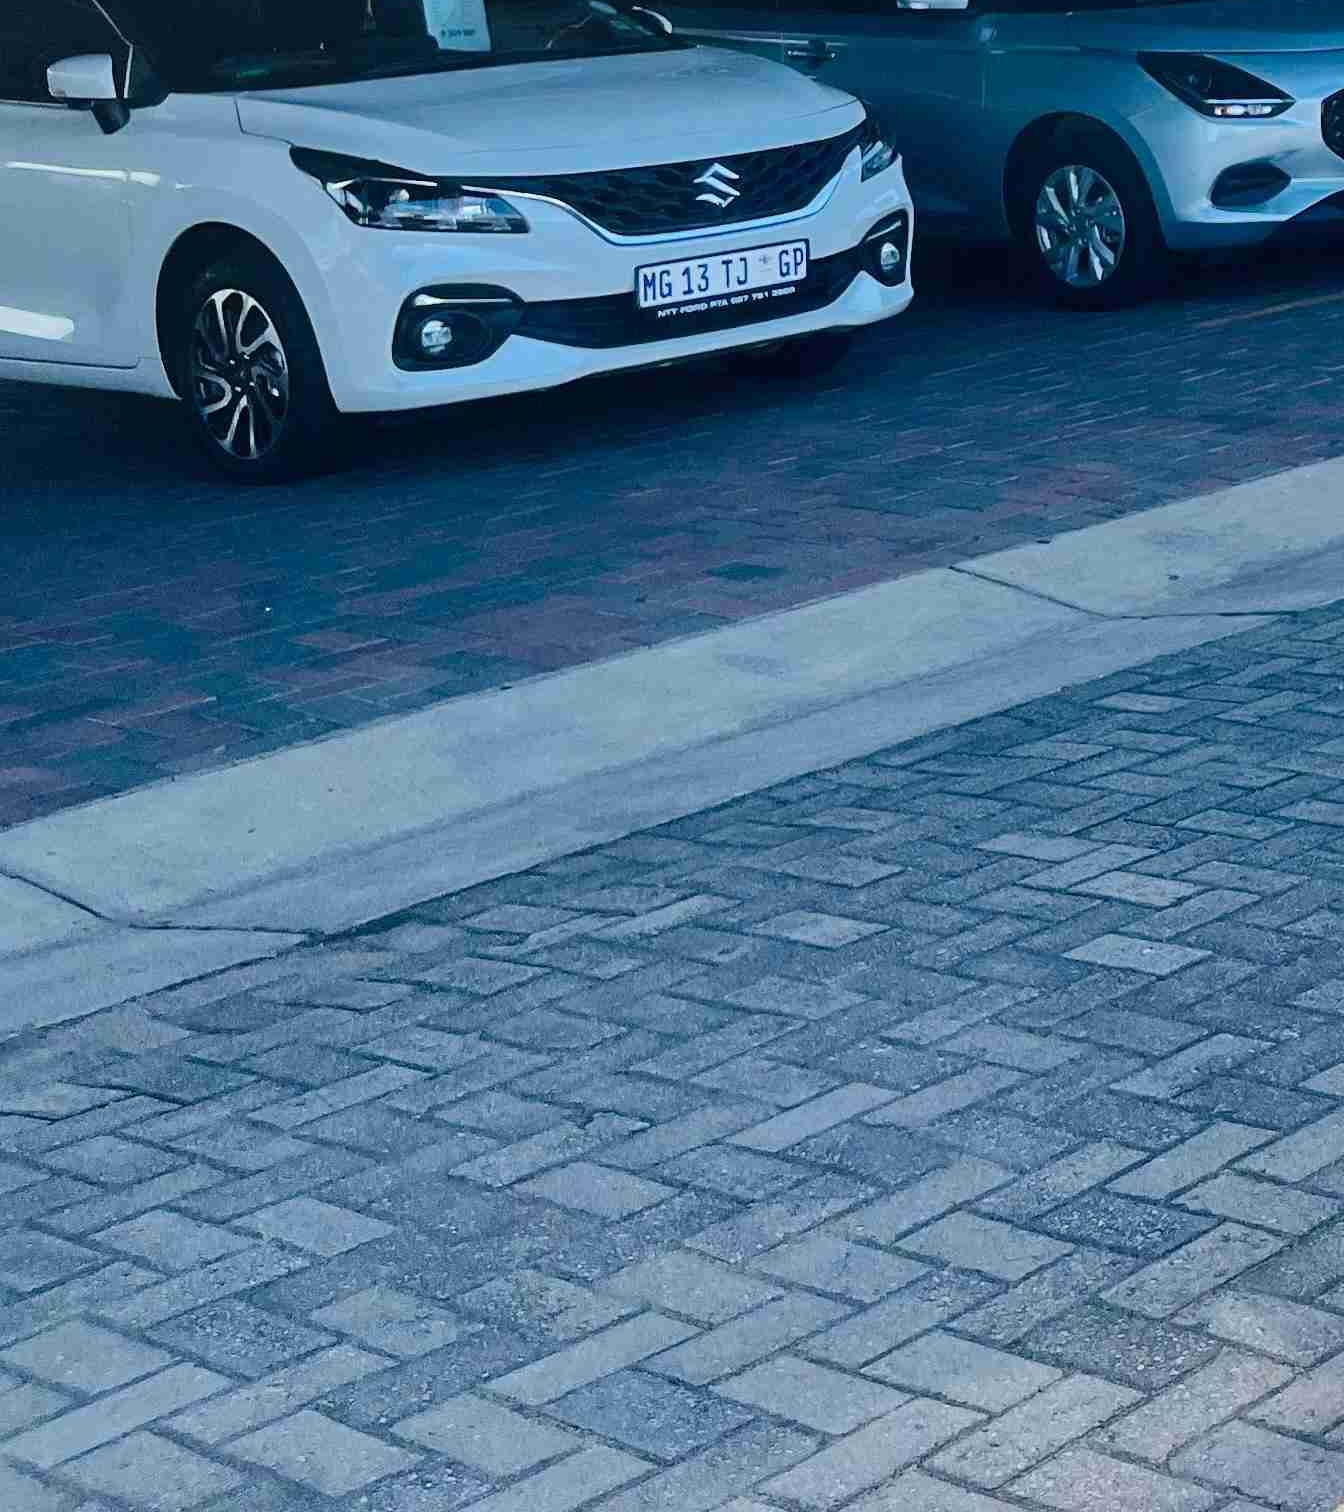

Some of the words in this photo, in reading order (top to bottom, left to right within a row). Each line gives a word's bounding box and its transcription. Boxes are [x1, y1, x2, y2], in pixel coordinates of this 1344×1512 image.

[643, 269, 672, 302] MG
[681, 263, 709, 296] 13
[721, 256, 748, 289] TJ
[778, 247, 804, 278] GP
